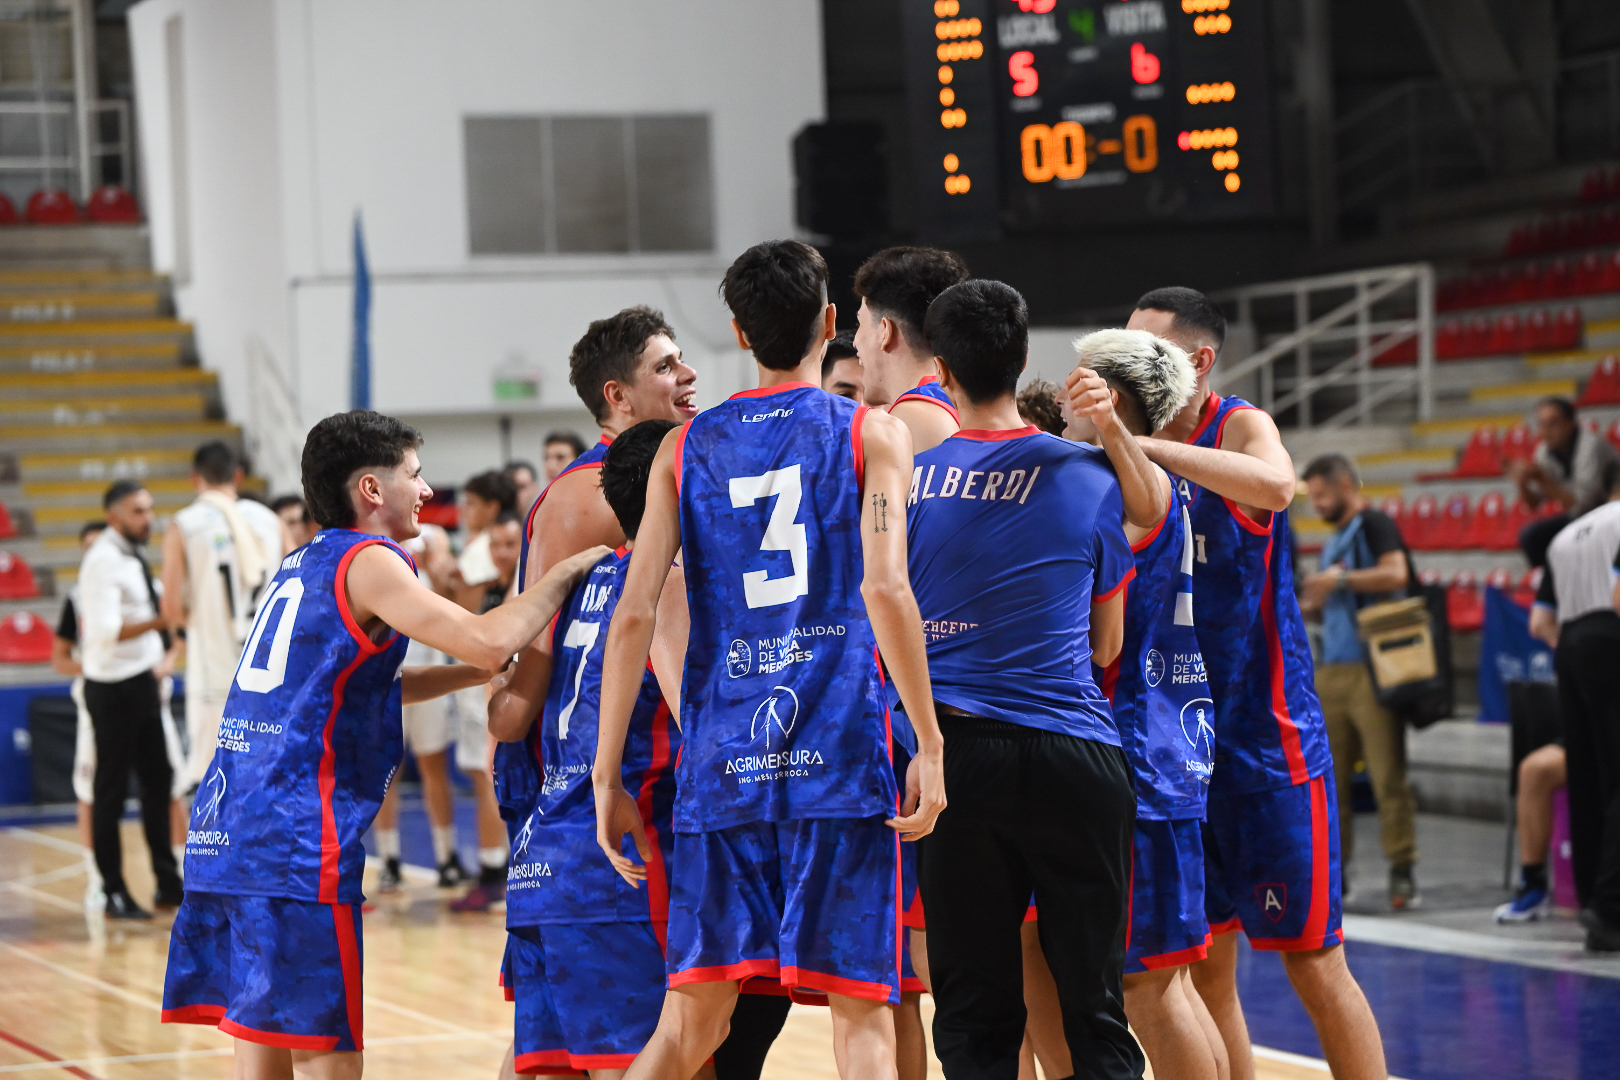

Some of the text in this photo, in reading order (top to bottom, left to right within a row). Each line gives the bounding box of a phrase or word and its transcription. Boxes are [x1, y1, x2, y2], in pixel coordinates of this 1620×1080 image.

[907, 464, 1041, 508] ALBERDI
[729, 463, 808, 609] 3
[921, 620, 979, 634] ERCED
[759, 651, 777, 662] DE
[558, 619, 600, 740] 7
[1173, 664, 1191, 674] DE
[725, 750, 824, 774] AGRIMENSURA
[1265, 888, 1282, 911] A
